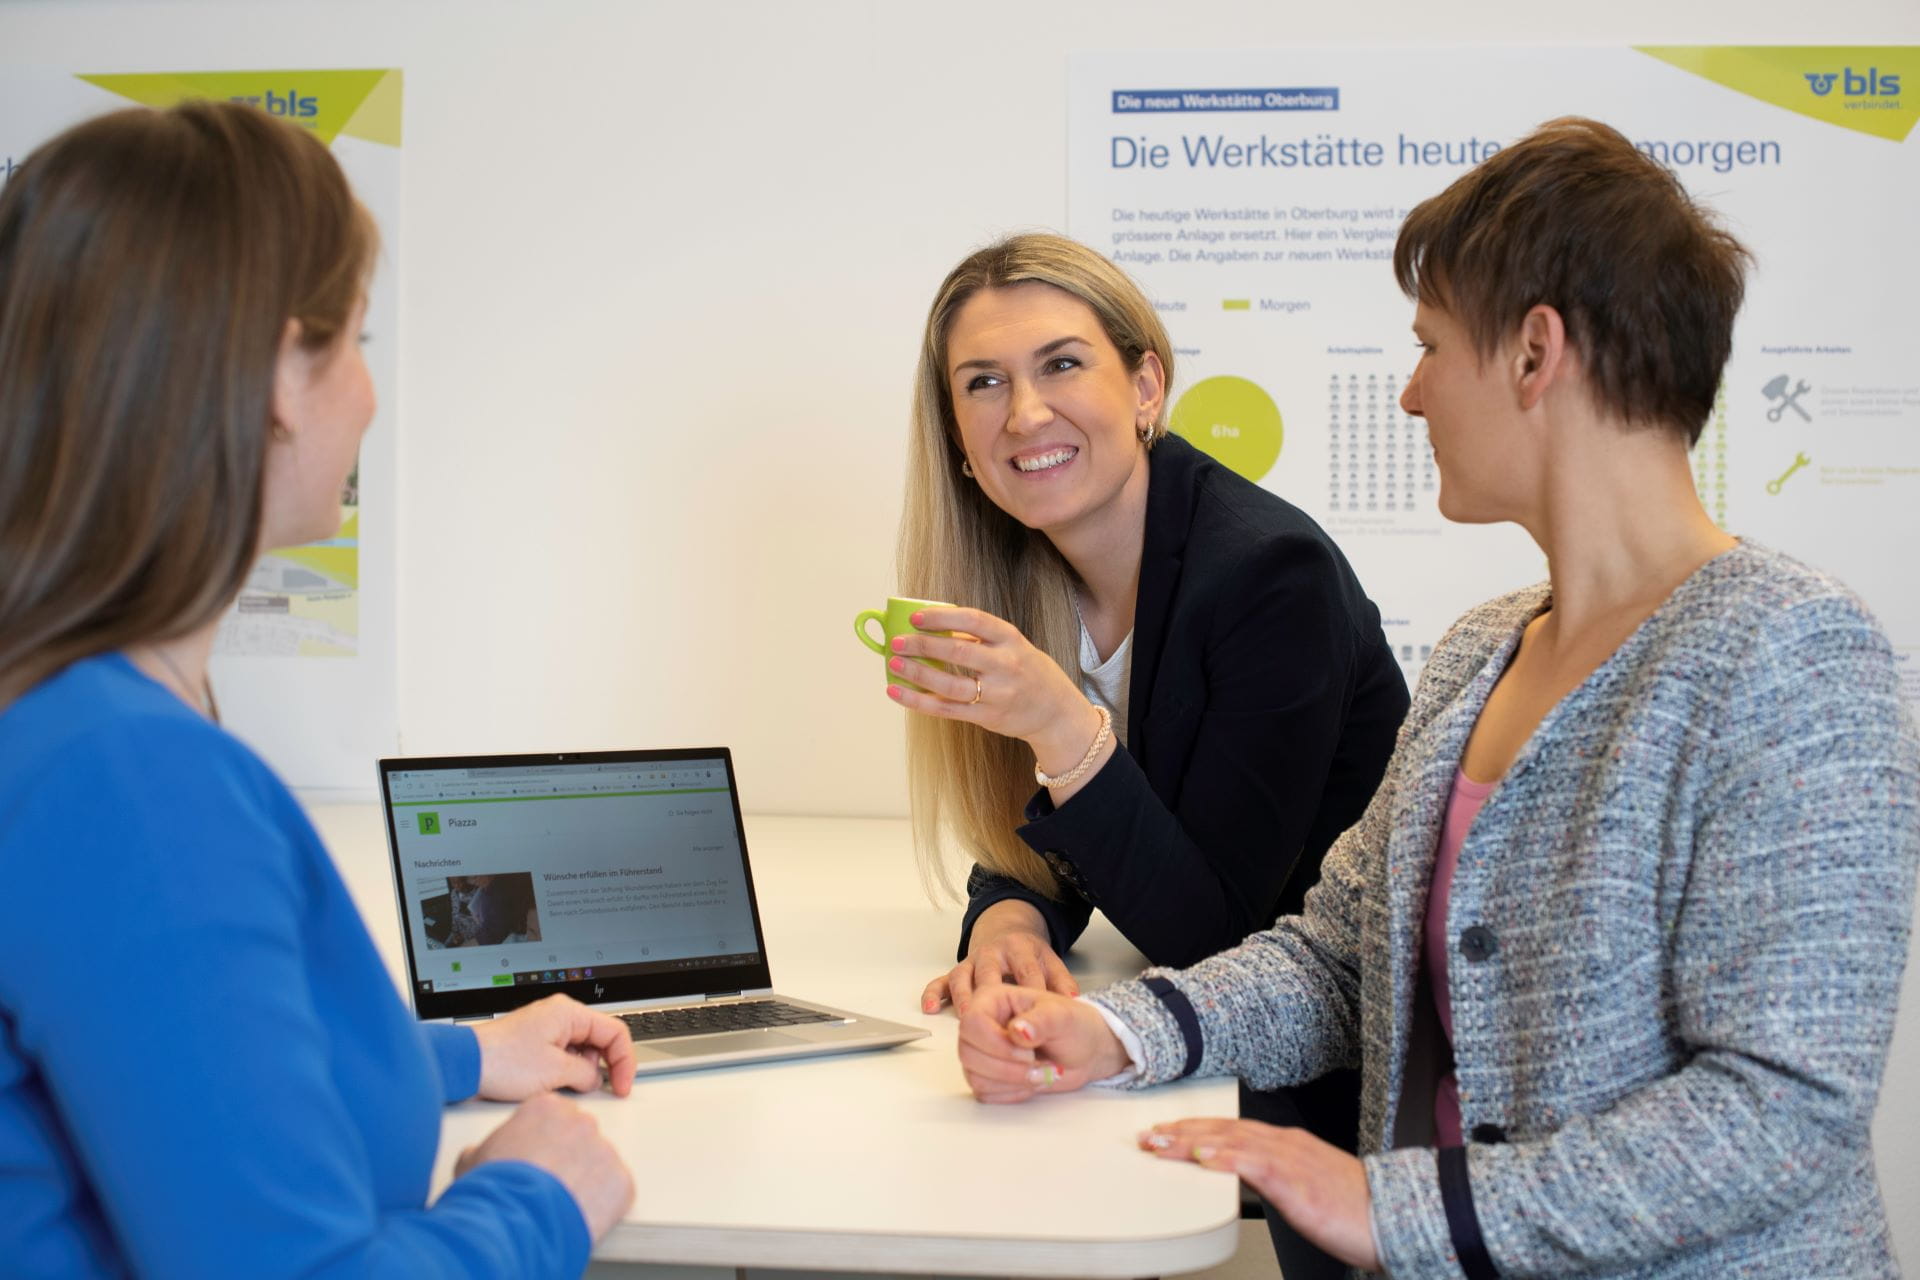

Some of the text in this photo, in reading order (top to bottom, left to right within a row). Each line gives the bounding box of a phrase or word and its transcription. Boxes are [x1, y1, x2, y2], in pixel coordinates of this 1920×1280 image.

[1844, 67, 1901, 95] bls
[266, 88, 318, 116] bls
[1117, 92, 1333, 109] Die neue Werkstätte Oberburg
[1111, 133, 1502, 169] Die Werkstätte heute
[1634, 140, 1781, 173] morgen
[1112, 208, 1135, 221] Die
[1139, 209, 1191, 223] heutige
[1195, 208, 1270, 221] Werkstätte
[1274, 207, 1287, 219] in
[1291, 206, 1358, 222] Oberburg
[1362, 208, 1394, 219] wird
[1112, 227, 1395, 244] grössere Anlage ersetzt. Hier ein Vergleic
[1112, 249, 1393, 264] Anlage. Die Angaben zur neuen Werkstä
[1260, 299, 1311, 314] Morgen
[448, 817, 478, 828] Piazza
[414, 858, 462, 869] Nachrichten
[543, 865, 663, 882] Wünsche erfüllen im Führerstand
[594, 983, 604, 998] hp
